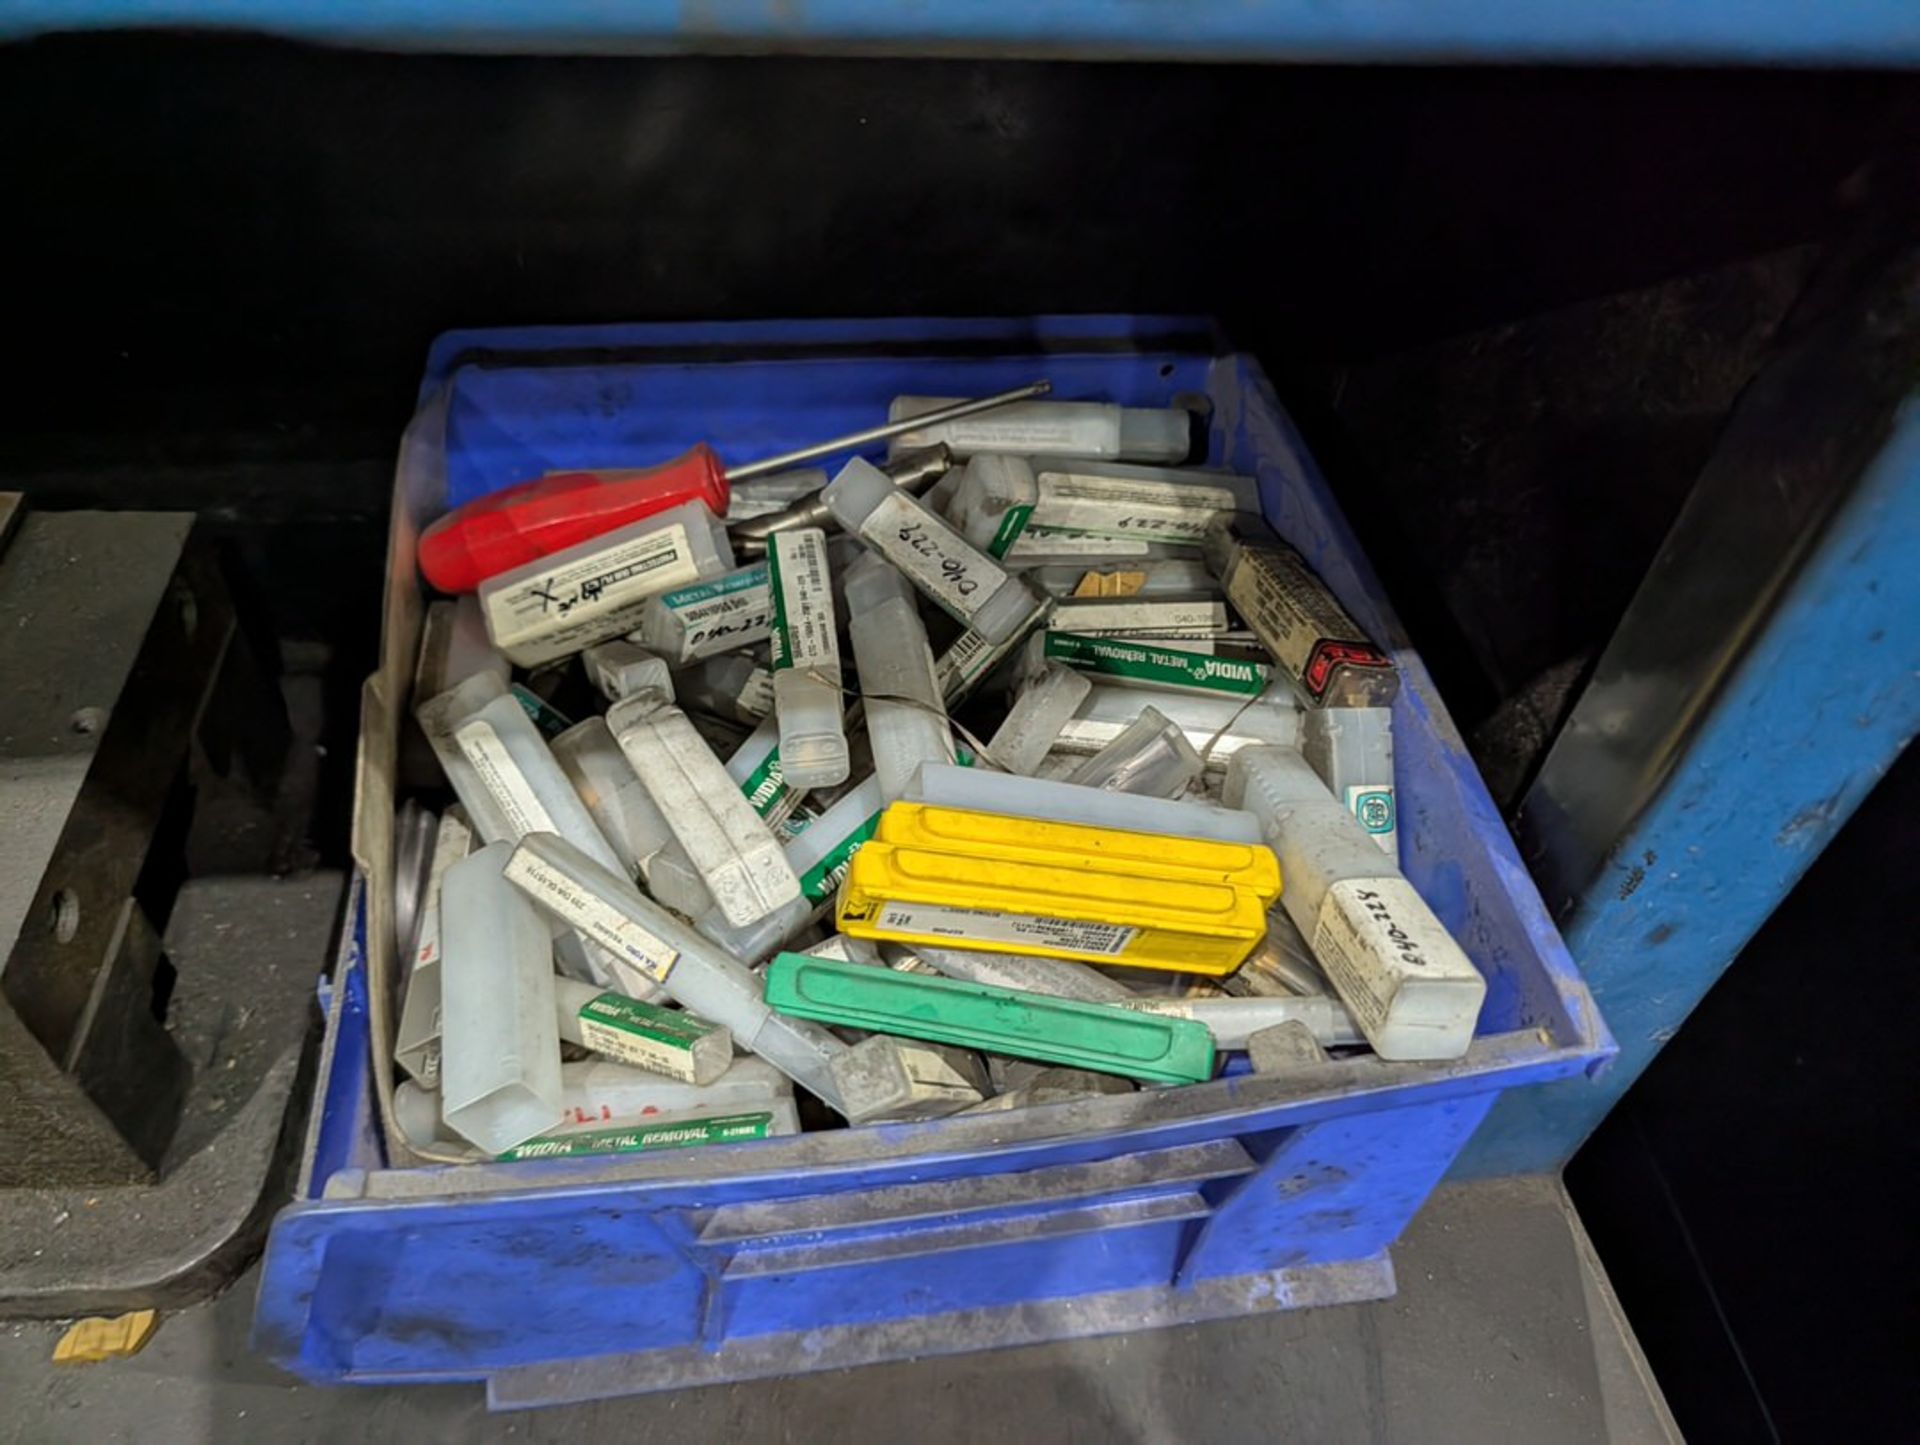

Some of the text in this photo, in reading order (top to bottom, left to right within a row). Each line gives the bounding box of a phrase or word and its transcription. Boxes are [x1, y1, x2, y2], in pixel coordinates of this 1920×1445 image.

[898, 518, 980, 597] 040-229
[1092, 644, 1148, 663] REMOVAL
[1151, 654, 1189, 668] METAL
[1204, 659, 1254, 682] WIDIA
[750, 771, 785, 809] WIDIA
[816, 853, 854, 895] WIDI
[515, 1142, 573, 1158] WIDIA
[591, 1134, 638, 1149] METAL
[642, 1127, 710, 1145] REMOVAL
